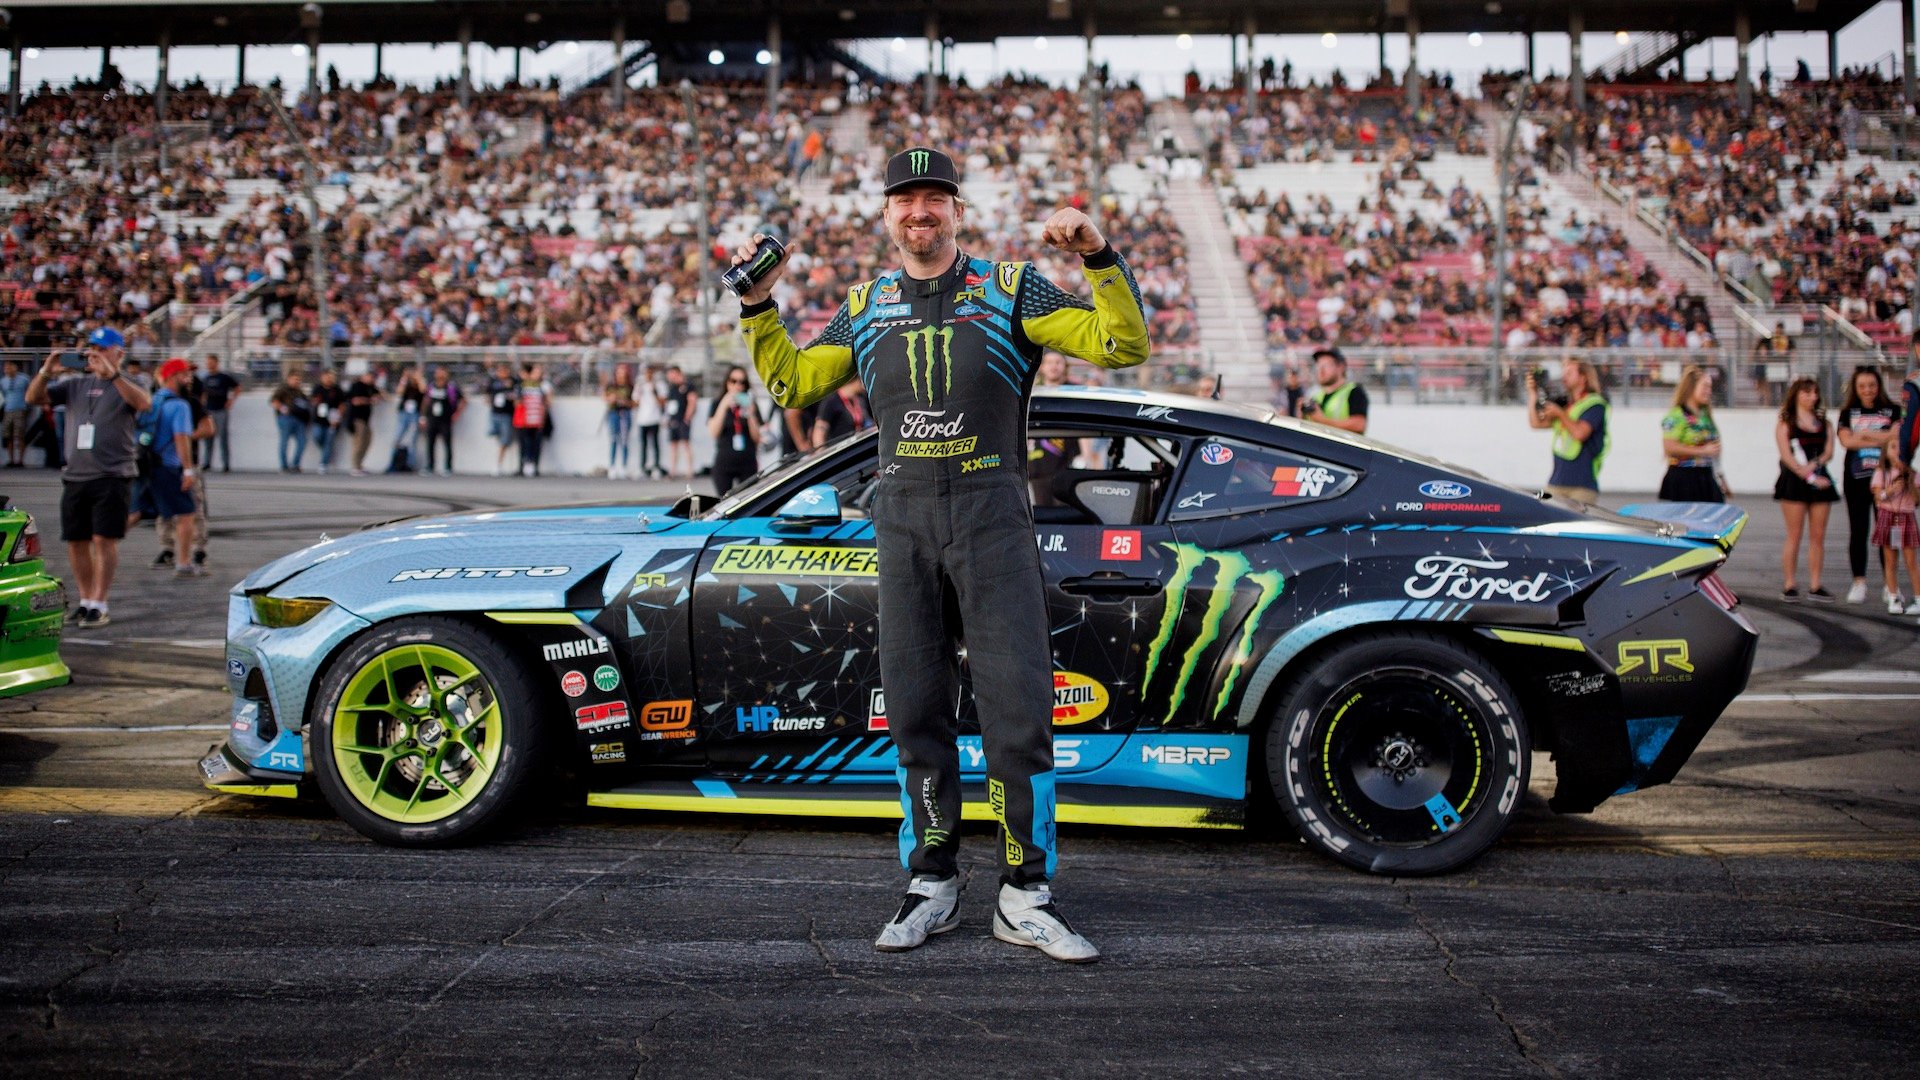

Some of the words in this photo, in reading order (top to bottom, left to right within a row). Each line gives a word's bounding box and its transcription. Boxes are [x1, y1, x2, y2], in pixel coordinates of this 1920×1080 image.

[870, 319, 922, 328] NITTO
[900, 410, 964, 438] Ford
[898, 439, 974, 455] FUN-HAVER
[1092, 486, 1131, 496] RECARO
[1429, 481, 1461, 496] Ford
[1396, 502, 1423, 512] FORD
[1424, 502, 1501, 512] PERFORMANCE
[1044, 534, 1068, 552] JR.
[1110, 536, 1131, 555] 25
[388, 566, 571, 583] NITTO
[1404, 556, 1551, 602] Ford
[543, 636, 609, 661] MAHLE
[598, 671, 614, 680] NTK
[1053, 685, 1095, 705] NZOIL
[641, 730, 696, 741] GEARWRENCH
[592, 752, 626, 760] RACING
[1142, 745, 1231, 765] MBRP
